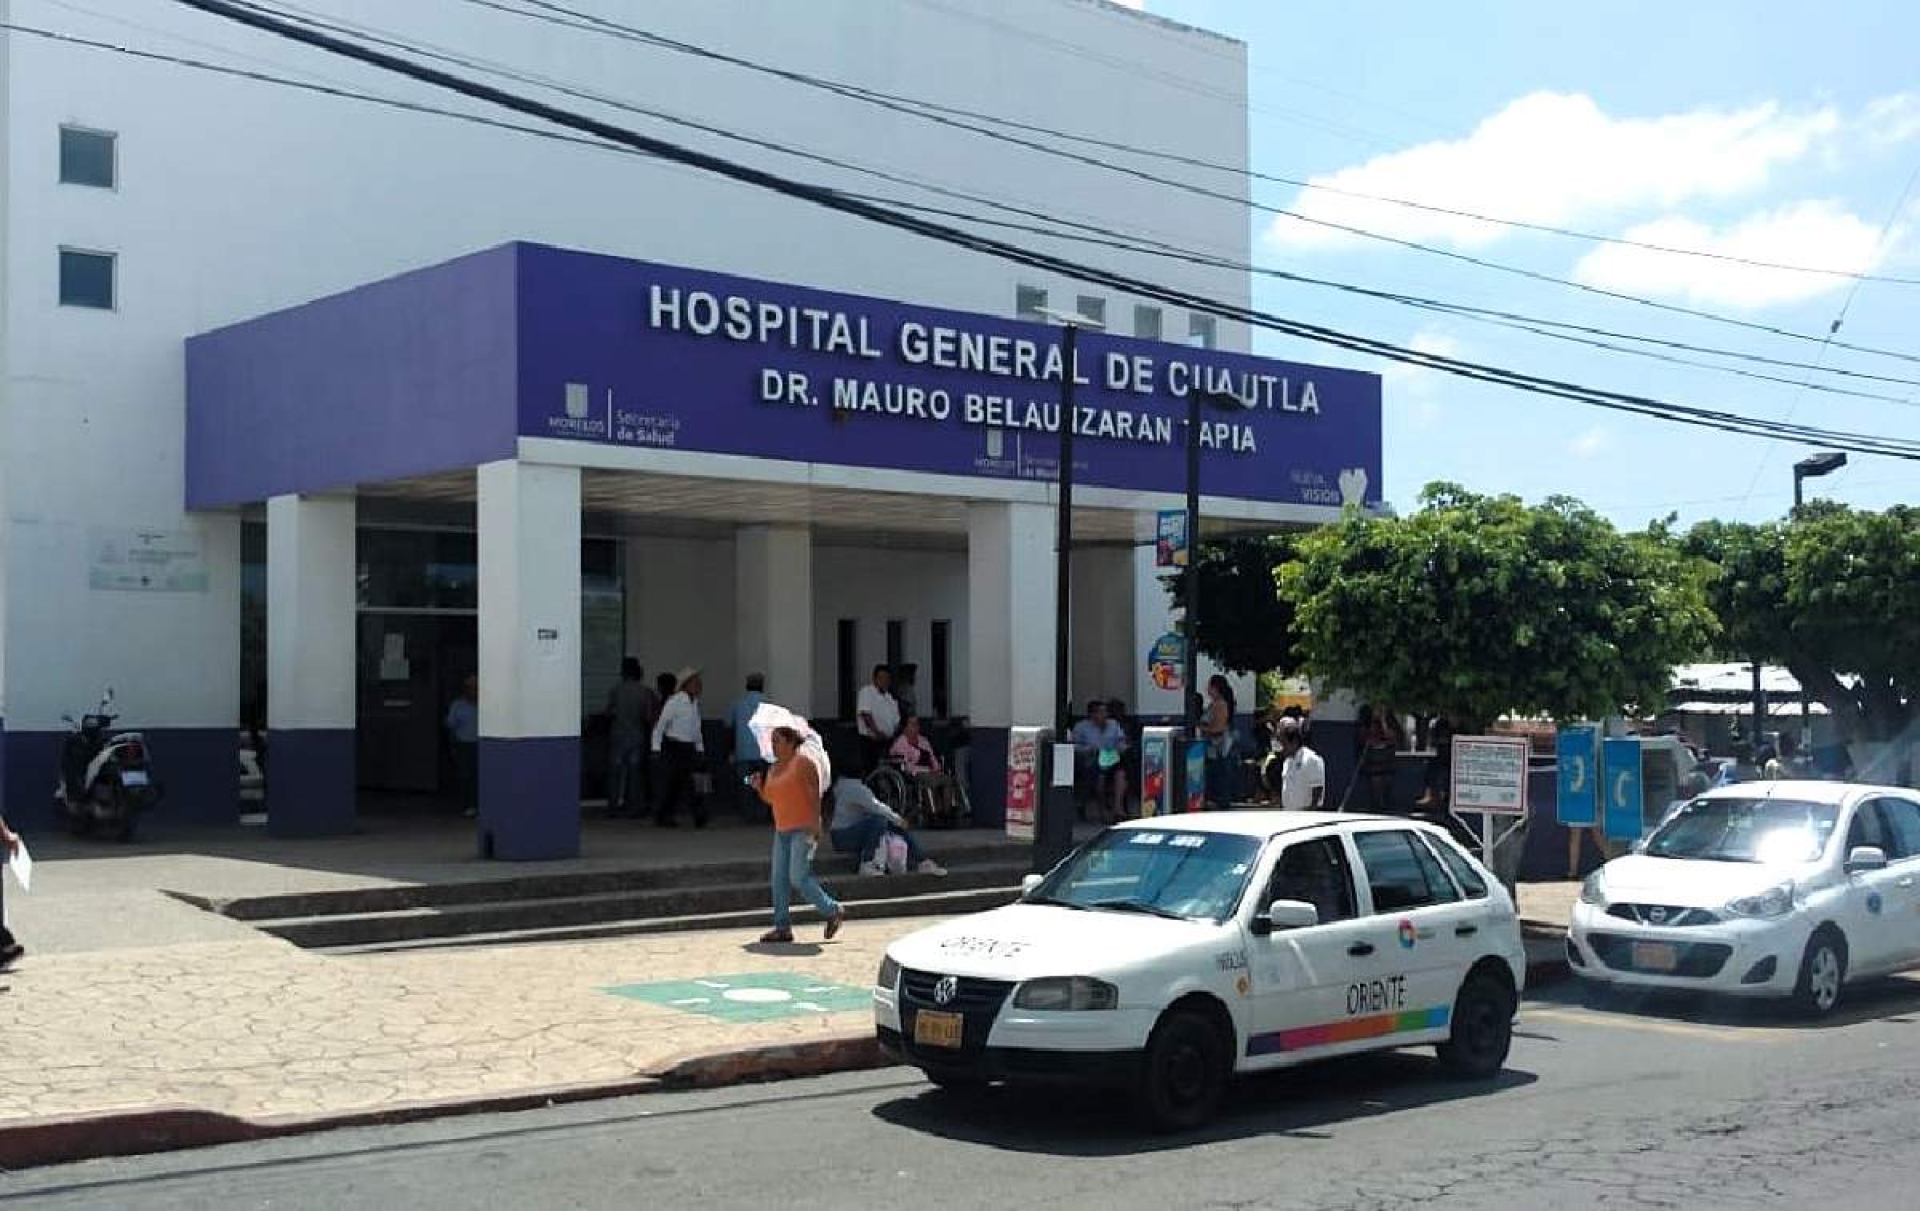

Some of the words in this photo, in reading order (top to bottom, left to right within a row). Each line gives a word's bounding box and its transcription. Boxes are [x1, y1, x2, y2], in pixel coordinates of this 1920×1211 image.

[651, 285, 881, 357] HOSPITAL
[901, 322, 1089, 384] GENERAL
[1106, 352, 1153, 393] DE
[761, 369, 818, 406] DR.
[833, 379, 950, 420] MAURO
[965, 393, 1171, 444] BELAUZARAN
[1181, 418, 1256, 451] APIA
[1346, 974, 1408, 1015] ORIENTE
